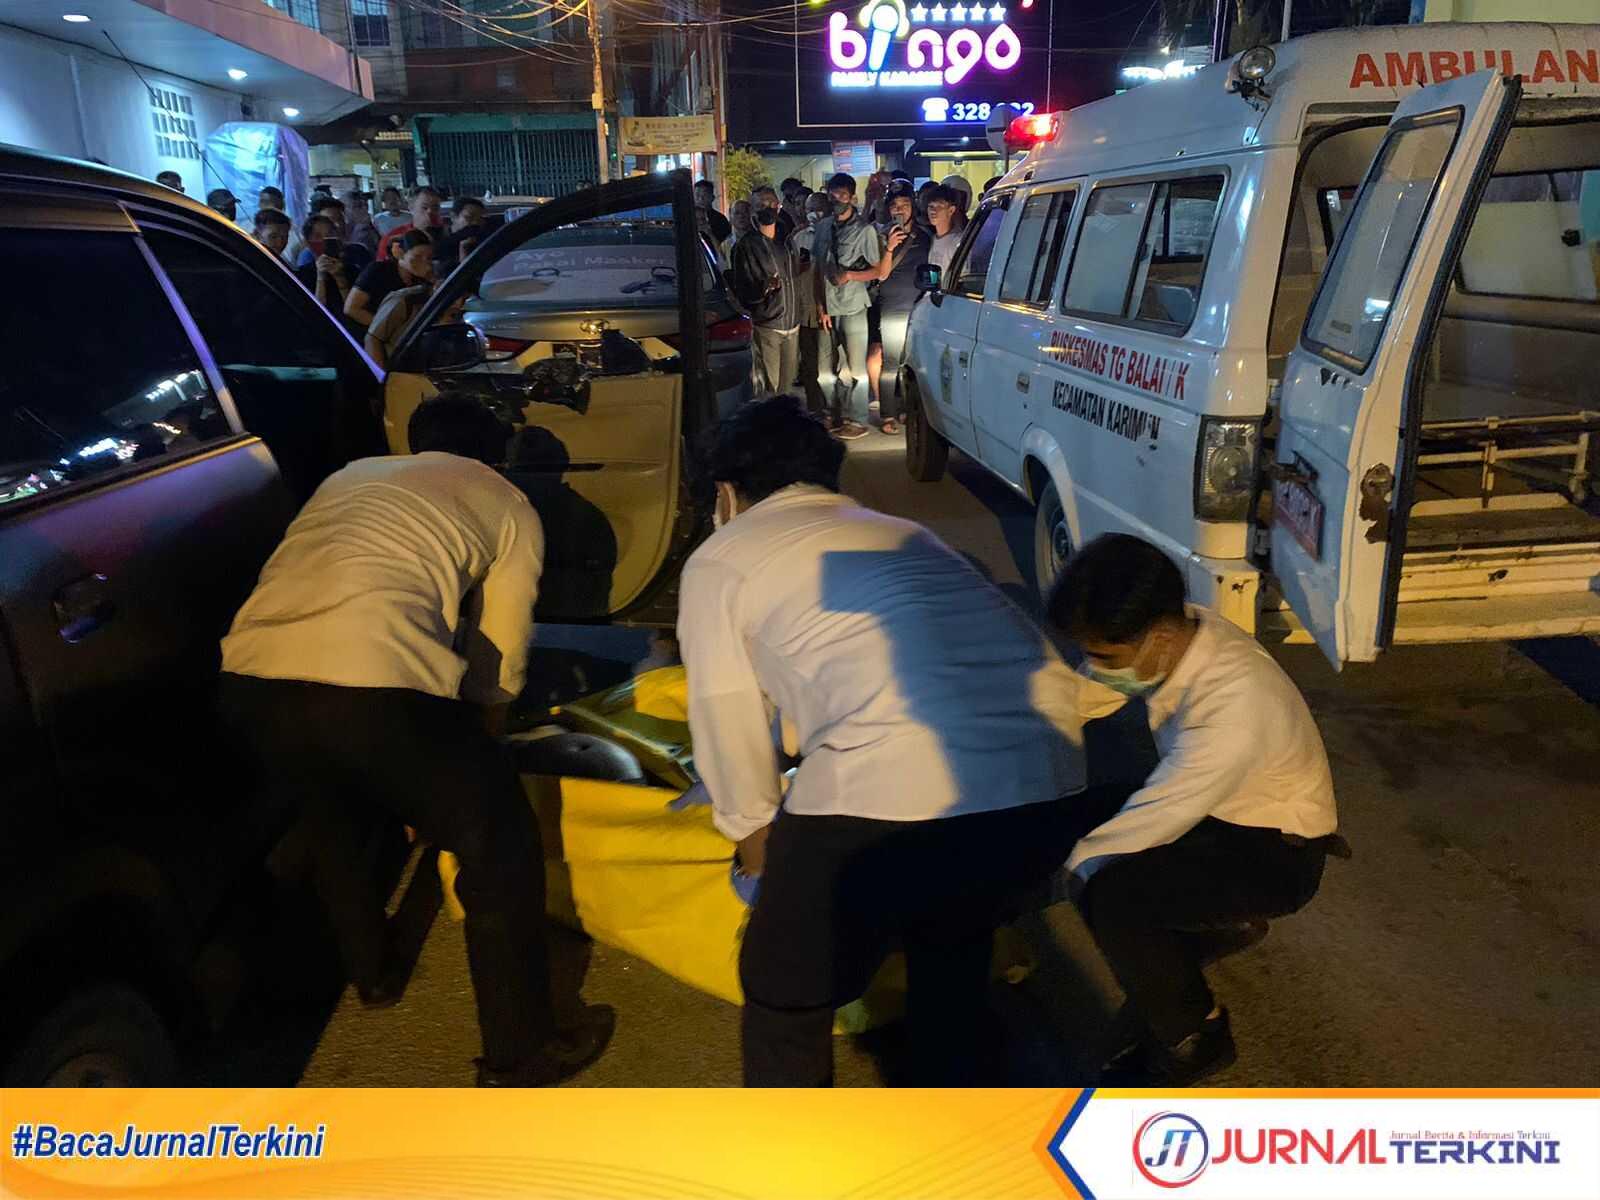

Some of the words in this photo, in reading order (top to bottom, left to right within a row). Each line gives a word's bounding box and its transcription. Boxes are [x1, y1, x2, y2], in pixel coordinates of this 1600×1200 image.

[1048, 330, 1109, 375] PUSKESMAS
[1109, 345, 1126, 381] TG
[1052, 379, 1107, 427] KECAMATAN
